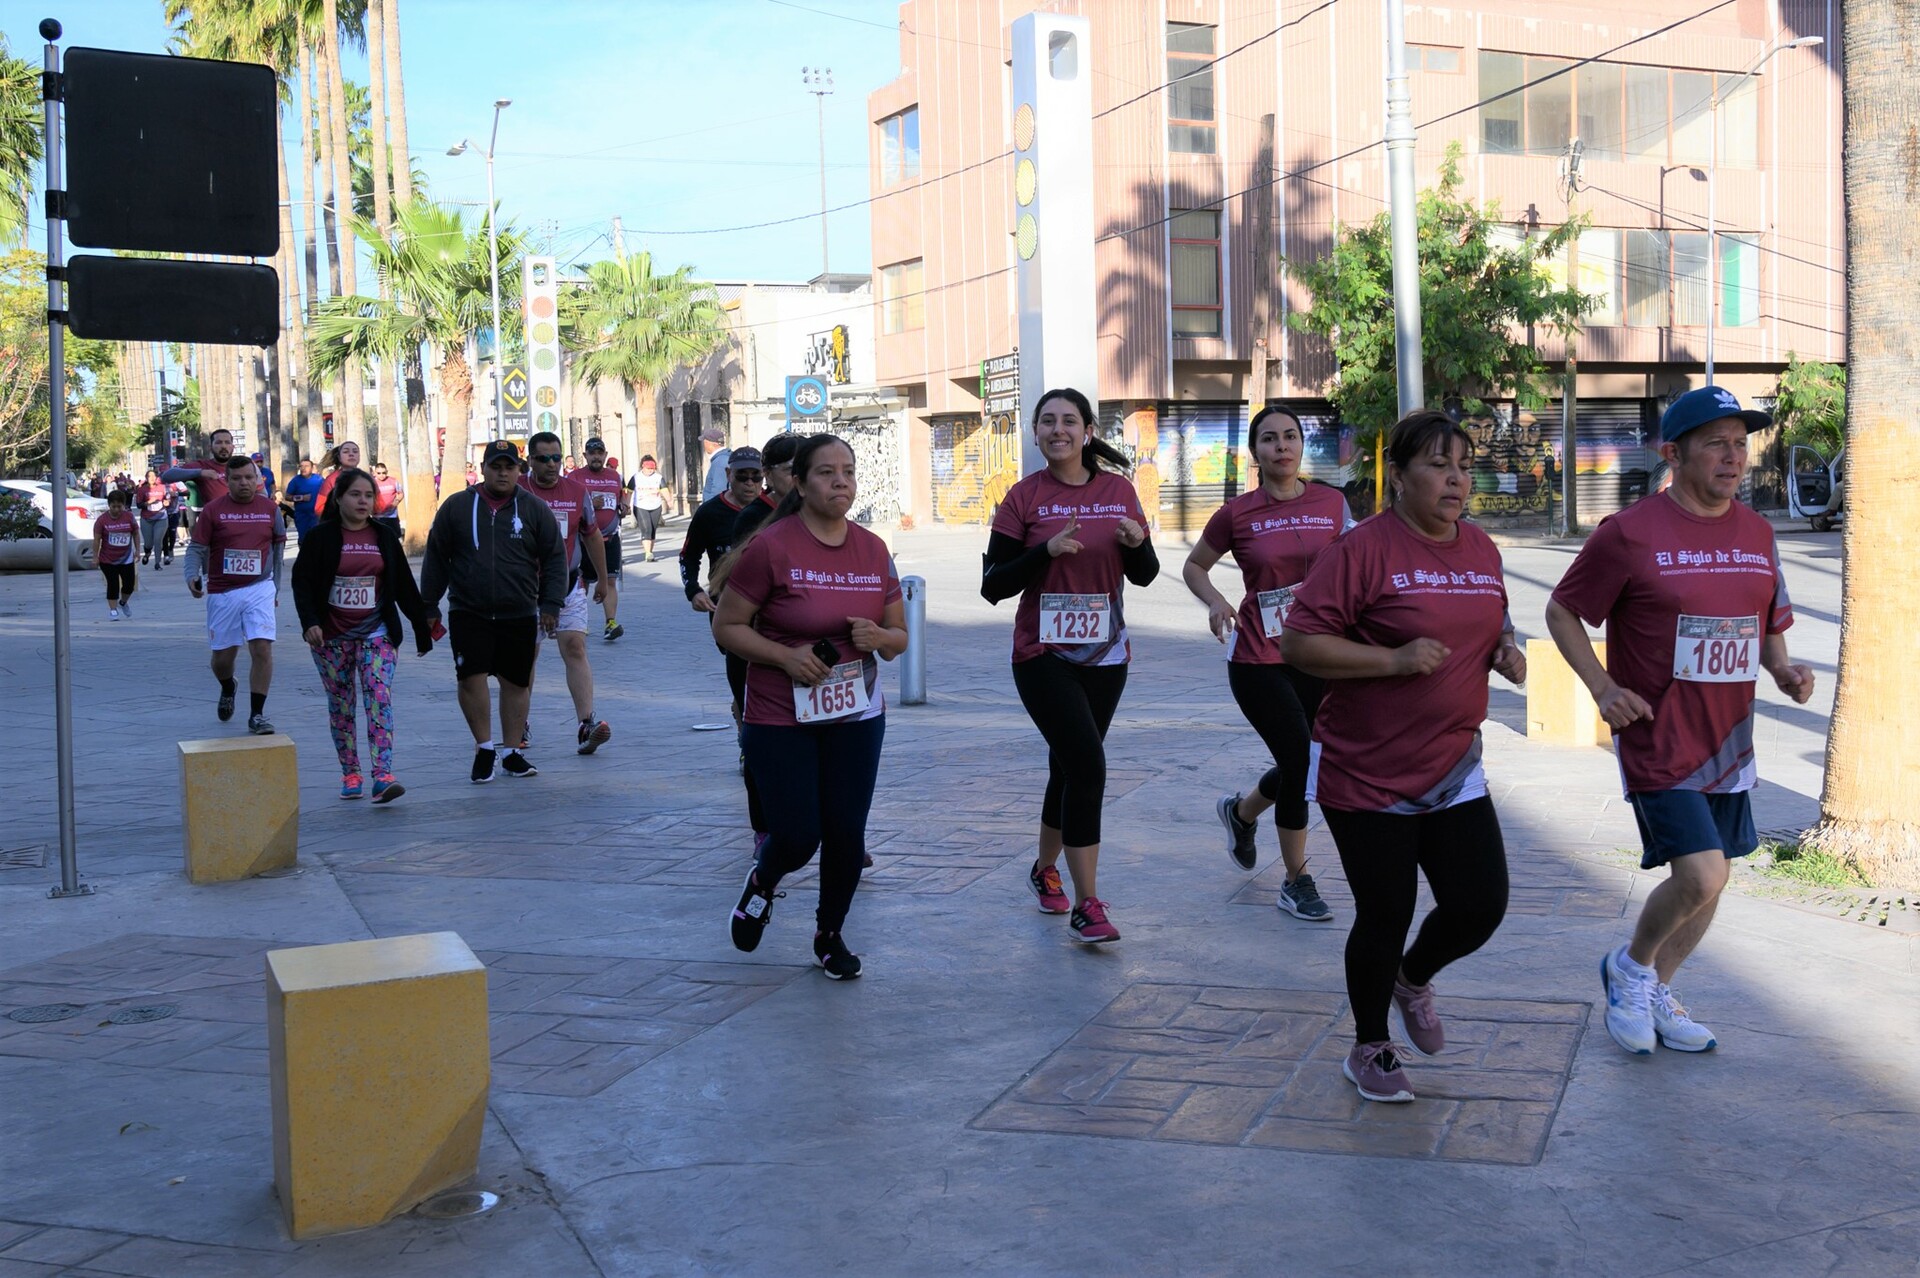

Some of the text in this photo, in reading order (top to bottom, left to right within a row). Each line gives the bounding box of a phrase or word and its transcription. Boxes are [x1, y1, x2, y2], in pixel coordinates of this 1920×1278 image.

[790, 422, 827, 433] PERMITIDO
[1038, 504, 1126, 516] El Siglo de Torreón
[1479, 496, 1504, 509] VIVA
[1507, 496, 1520, 508] LA
[1251, 522, 1262, 531] El
[1264, 518, 1288, 528] Siglo
[1302, 516, 1334, 524] Torreón
[230, 559, 255, 572] 1245
[1656, 552, 1674, 566] El
[1678, 550, 1712, 566] Siglo
[1715, 550, 1730, 563] de
[791, 569, 882, 584] El Siglo de Torreón
[1392, 574, 1410, 588] El
[1414, 570, 1448, 586] Siglo
[1449, 572, 1466, 585] de
[336, 588, 368, 605] 1230
[1053, 612, 1100, 638] 1232
[1693, 640, 1749, 676] 1804
[808, 681, 856, 715] 1655
